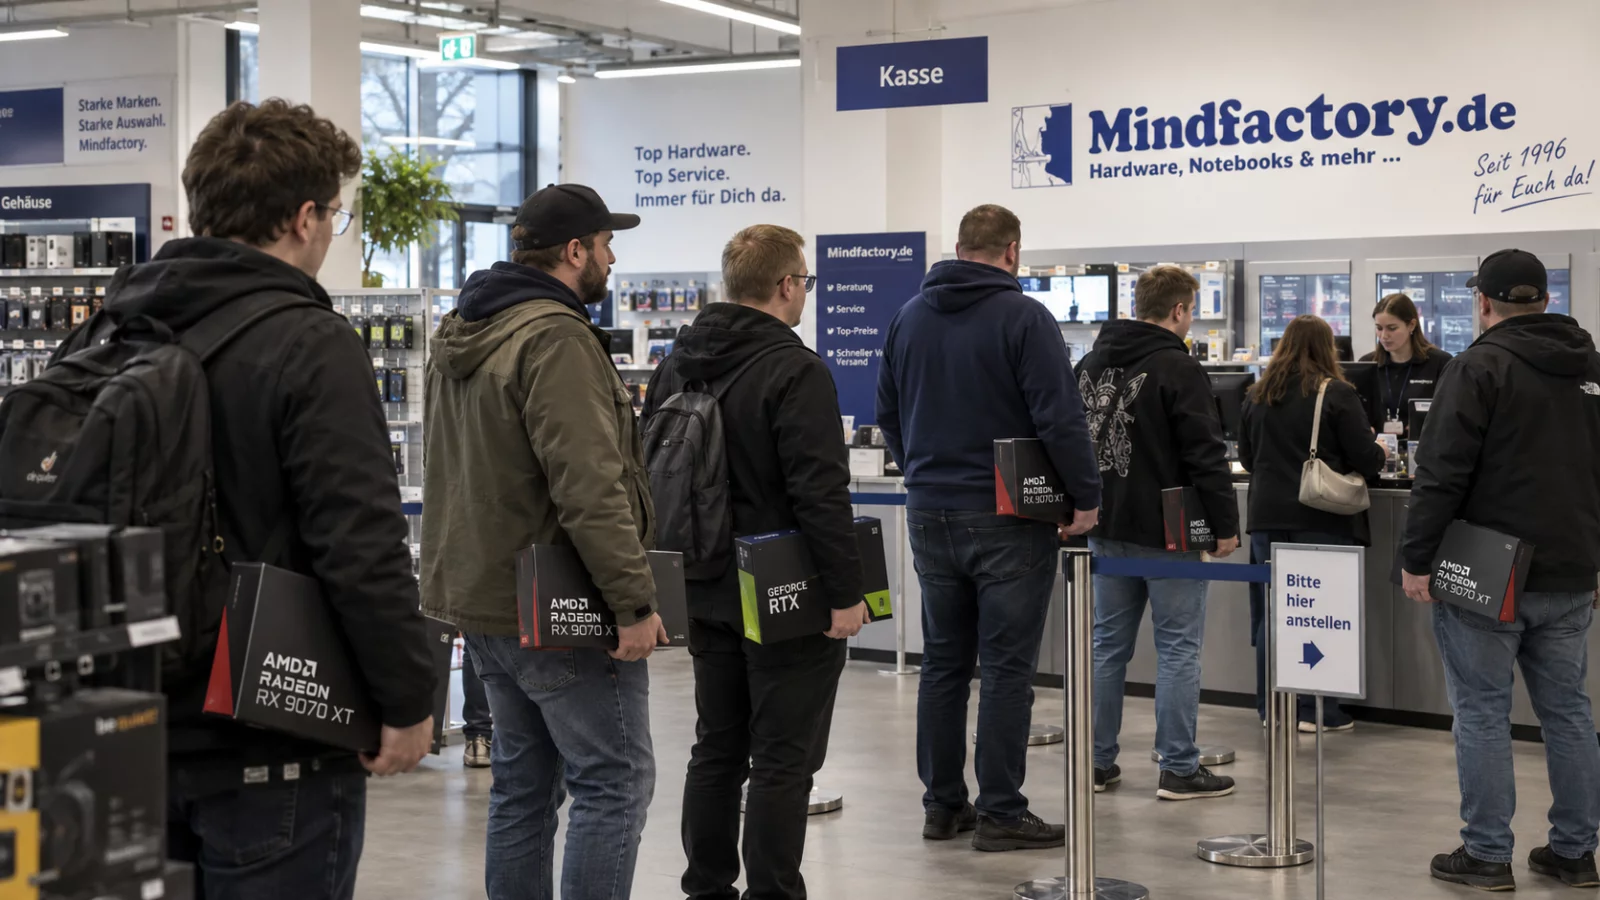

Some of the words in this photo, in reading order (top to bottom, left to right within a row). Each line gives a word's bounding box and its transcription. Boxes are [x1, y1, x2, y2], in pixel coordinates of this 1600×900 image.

[880, 65, 944, 87] Kasse
[78, 97, 113, 112] Starke
[116, 94, 161, 109] Marken.
[78, 117, 113, 132] Starke
[116, 113, 166, 129] Auswahl.
[1089, 93, 1516, 154] Mindfactory.de
[79, 137, 147, 152] Mindfactory.
[635, 146, 663, 164] Top
[668, 143, 751, 160] Hardware.
[1474, 152, 1512, 177] Seit
[1521, 138, 1567, 167] 1996
[1090, 161, 1183, 179] Hardware,
[1189, 152, 1293, 174] Notebooks
[1299, 150, 1314, 167] &
[1321, 148, 1376, 166] mehr
[635, 169, 663, 187] Top
[668, 166, 730, 183] Service.
[1473, 183, 1503, 214] für
[1511, 170, 1556, 200] Euch
[1564, 159, 1596, 188] da!
[1, 195, 52, 209] Gehäuse
[635, 192, 687, 207] Immer
[692, 190, 715, 205] für
[720, 188, 755, 204] Dich
[761, 187, 786, 202] da.
[827, 245, 913, 259] Mindfactory.de
[836, 283, 873, 293] Beratung
[836, 305, 865, 313] Service
[836, 326, 878, 336] Top-Preise
[836, 348, 873, 357] Schneller
[836, 358, 868, 366] Versand
[1023, 477, 1040, 486] AMD
[1023, 486, 1053, 495] RADEON
[1055, 494, 1064, 503] XT
[1440, 560, 1462, 573] AMD
[1286, 573, 1321, 589] Bitte
[1437, 569, 1477, 589] RADEON
[767, 580, 808, 597] GEFORCE
[1434, 578, 1449, 591] RX
[1449, 584, 1476, 600] 9070
[1476, 593, 1491, 605] XT
[551, 598, 578, 610] AMD
[768, 593, 800, 614] RTX
[1286, 593, 1315, 608] hier
[551, 612, 601, 623] RADEON
[1286, 615, 1351, 630] anstellen
[551, 625, 569, 635] RX
[571, 625, 602, 636] 9070
[262, 652, 303, 674] AMD
[259, 671, 330, 700] RADEON
[255, 689, 281, 709] RX
[285, 695, 328, 719] 9070
[331, 705, 355, 725] XT
